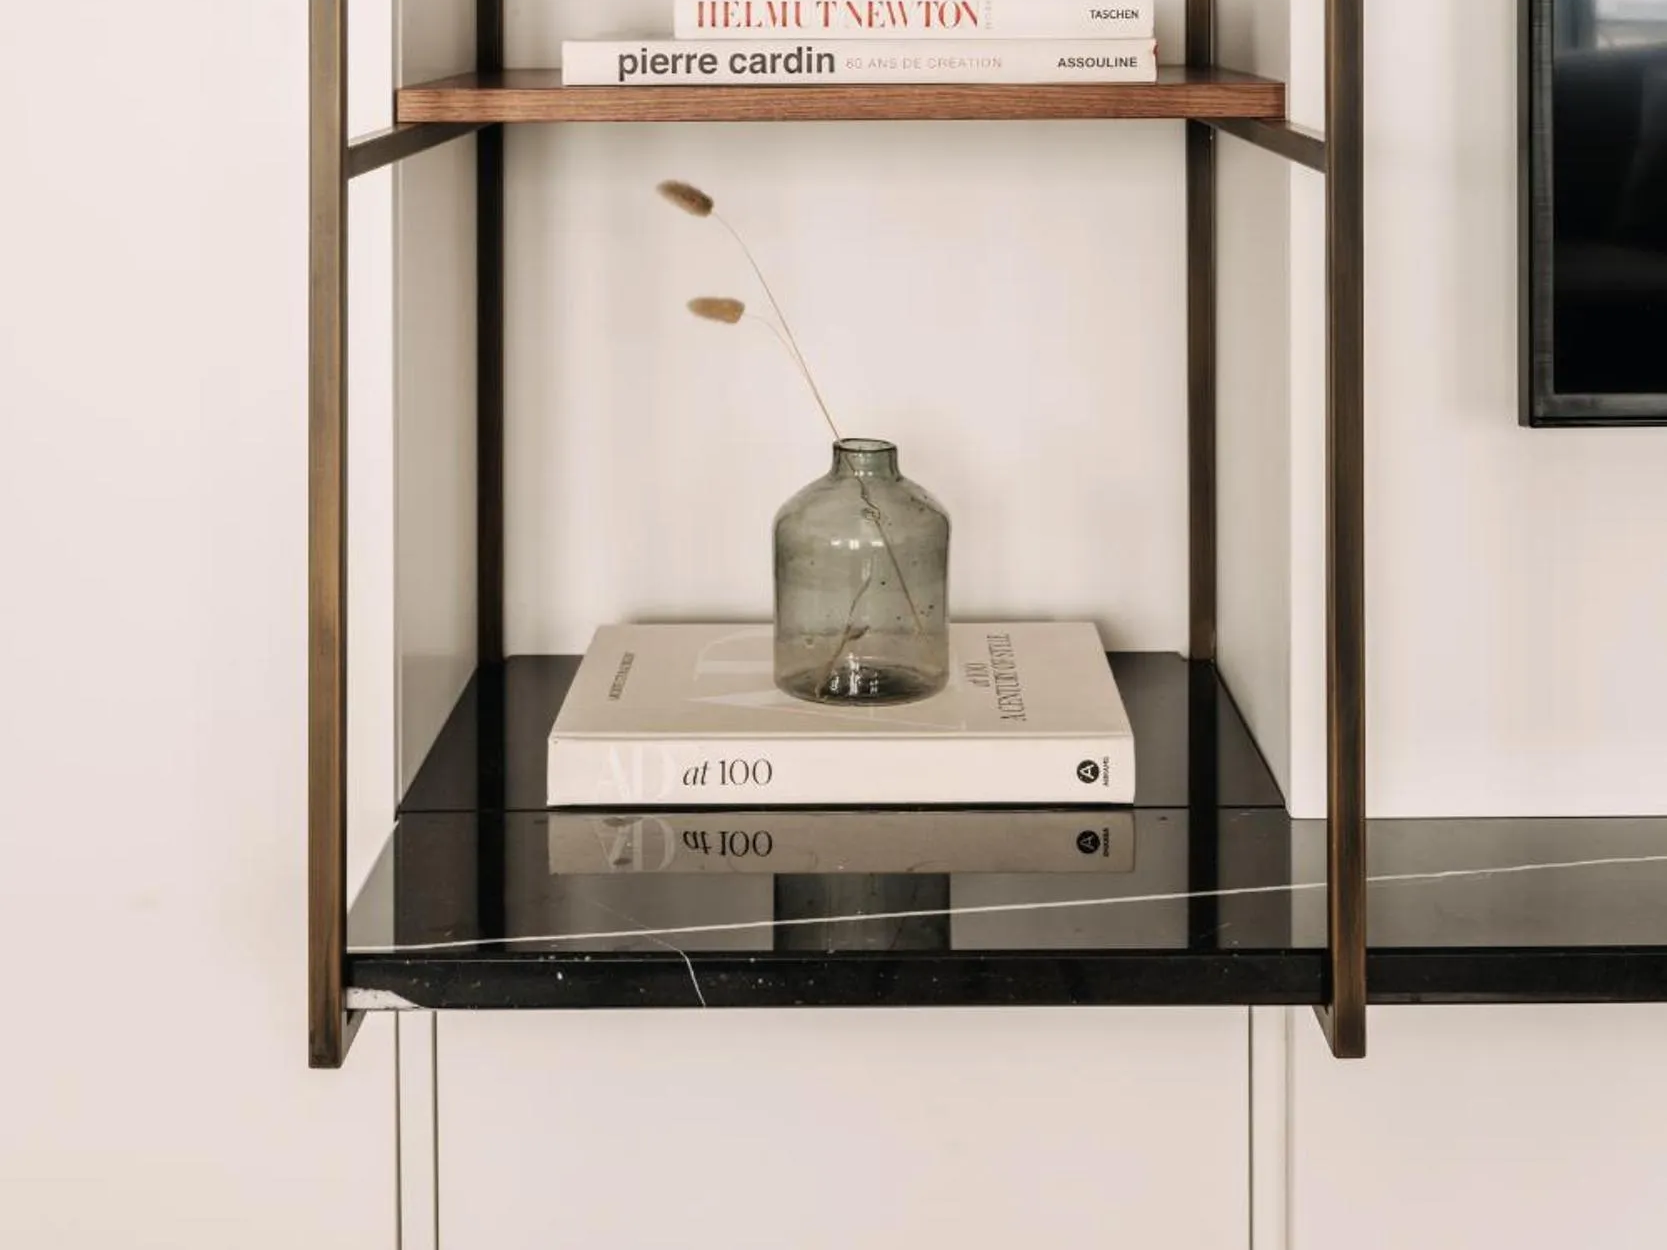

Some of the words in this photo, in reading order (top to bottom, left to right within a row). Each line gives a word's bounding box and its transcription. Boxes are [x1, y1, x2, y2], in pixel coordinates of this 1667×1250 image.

[697, 0, 838, 29] HELMUT
[843, 0, 979, 29] NEWTON
[1089, 9, 1140, 20] TASCHEN
[618, 47, 719, 82] pierre
[728, 46, 836, 74] cardin
[867, 57, 896, 69] ANS
[902, 57, 921, 69] DE
[1057, 57, 1139, 69] ASSOULINE
[682, 759, 710, 786] at
[718, 758, 773, 786] 100
